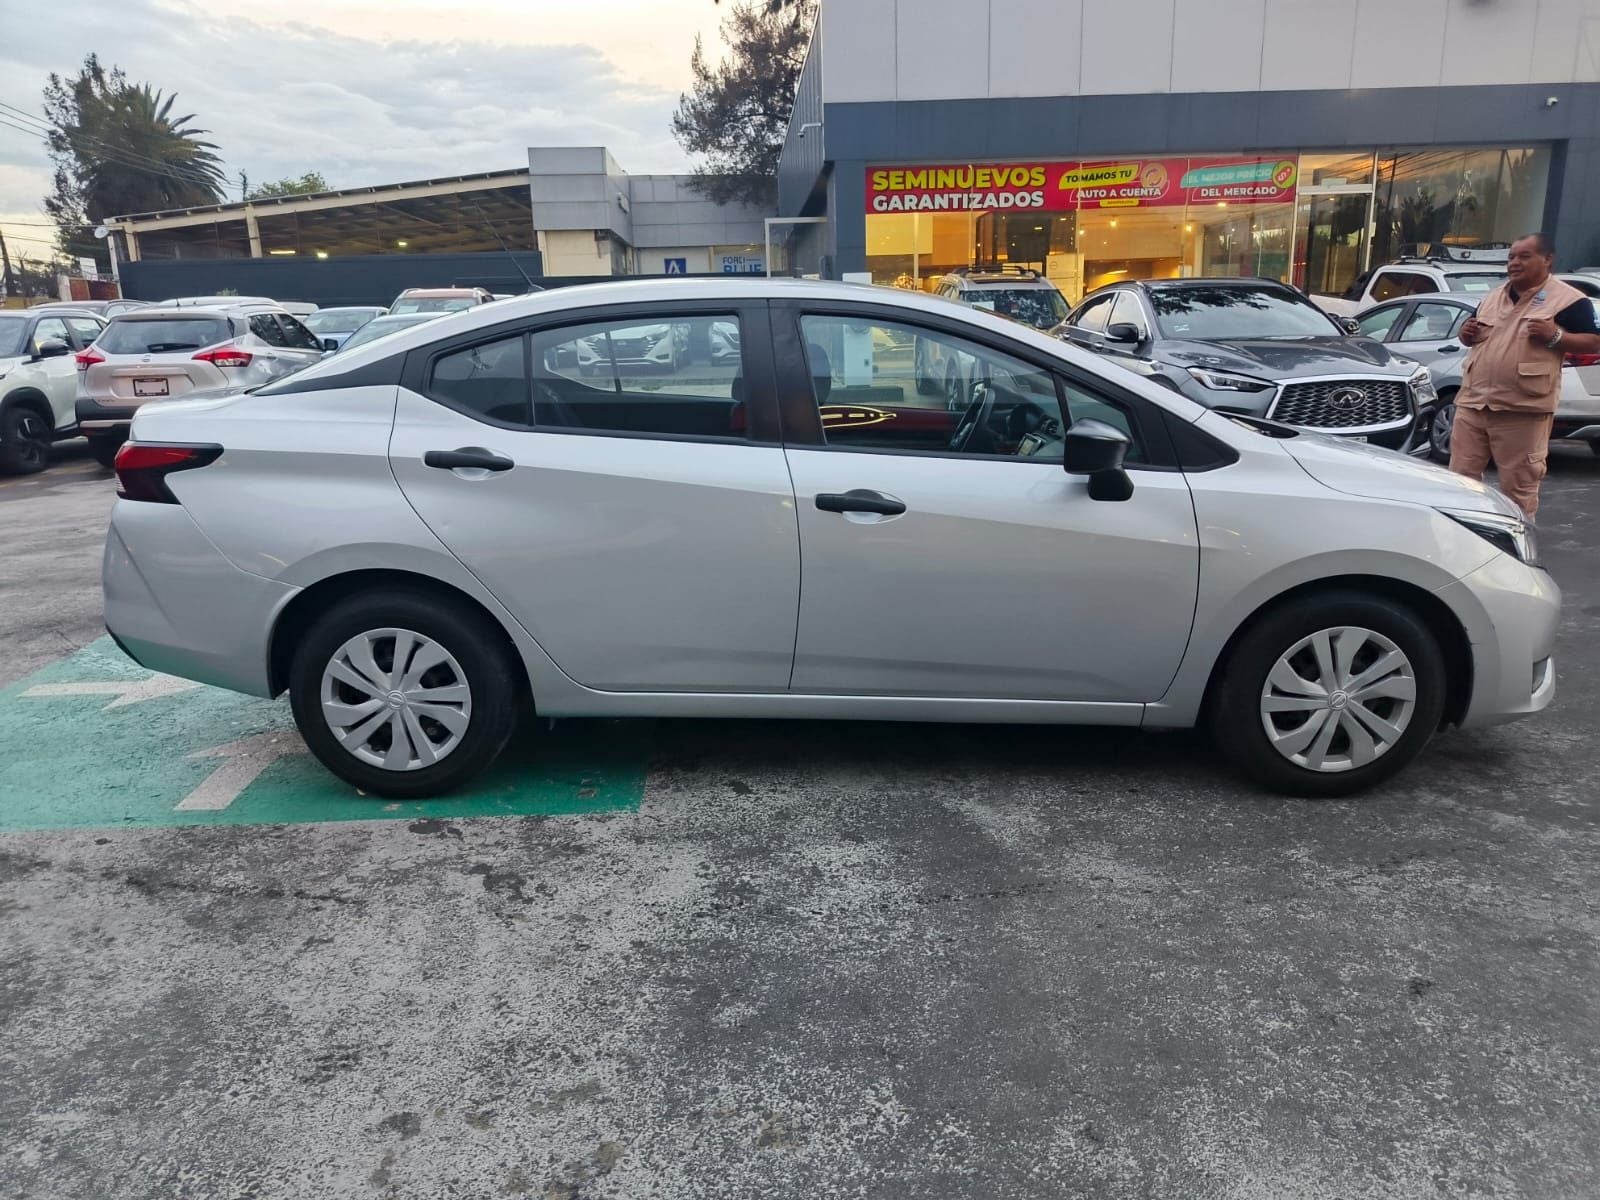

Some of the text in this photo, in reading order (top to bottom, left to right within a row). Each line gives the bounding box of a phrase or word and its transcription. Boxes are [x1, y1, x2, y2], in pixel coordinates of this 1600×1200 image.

[873, 166, 1046, 191] SEMINUEVOS
[1119, 170, 1132, 178] TU
[1236, 168, 1272, 179] PRECIO
[1076, 188, 1162, 198] AUTO A CUENTA
[1200, 186, 1277, 197] DEL MERCADO
[873, 191, 1044, 211] GARANTIZADOS
